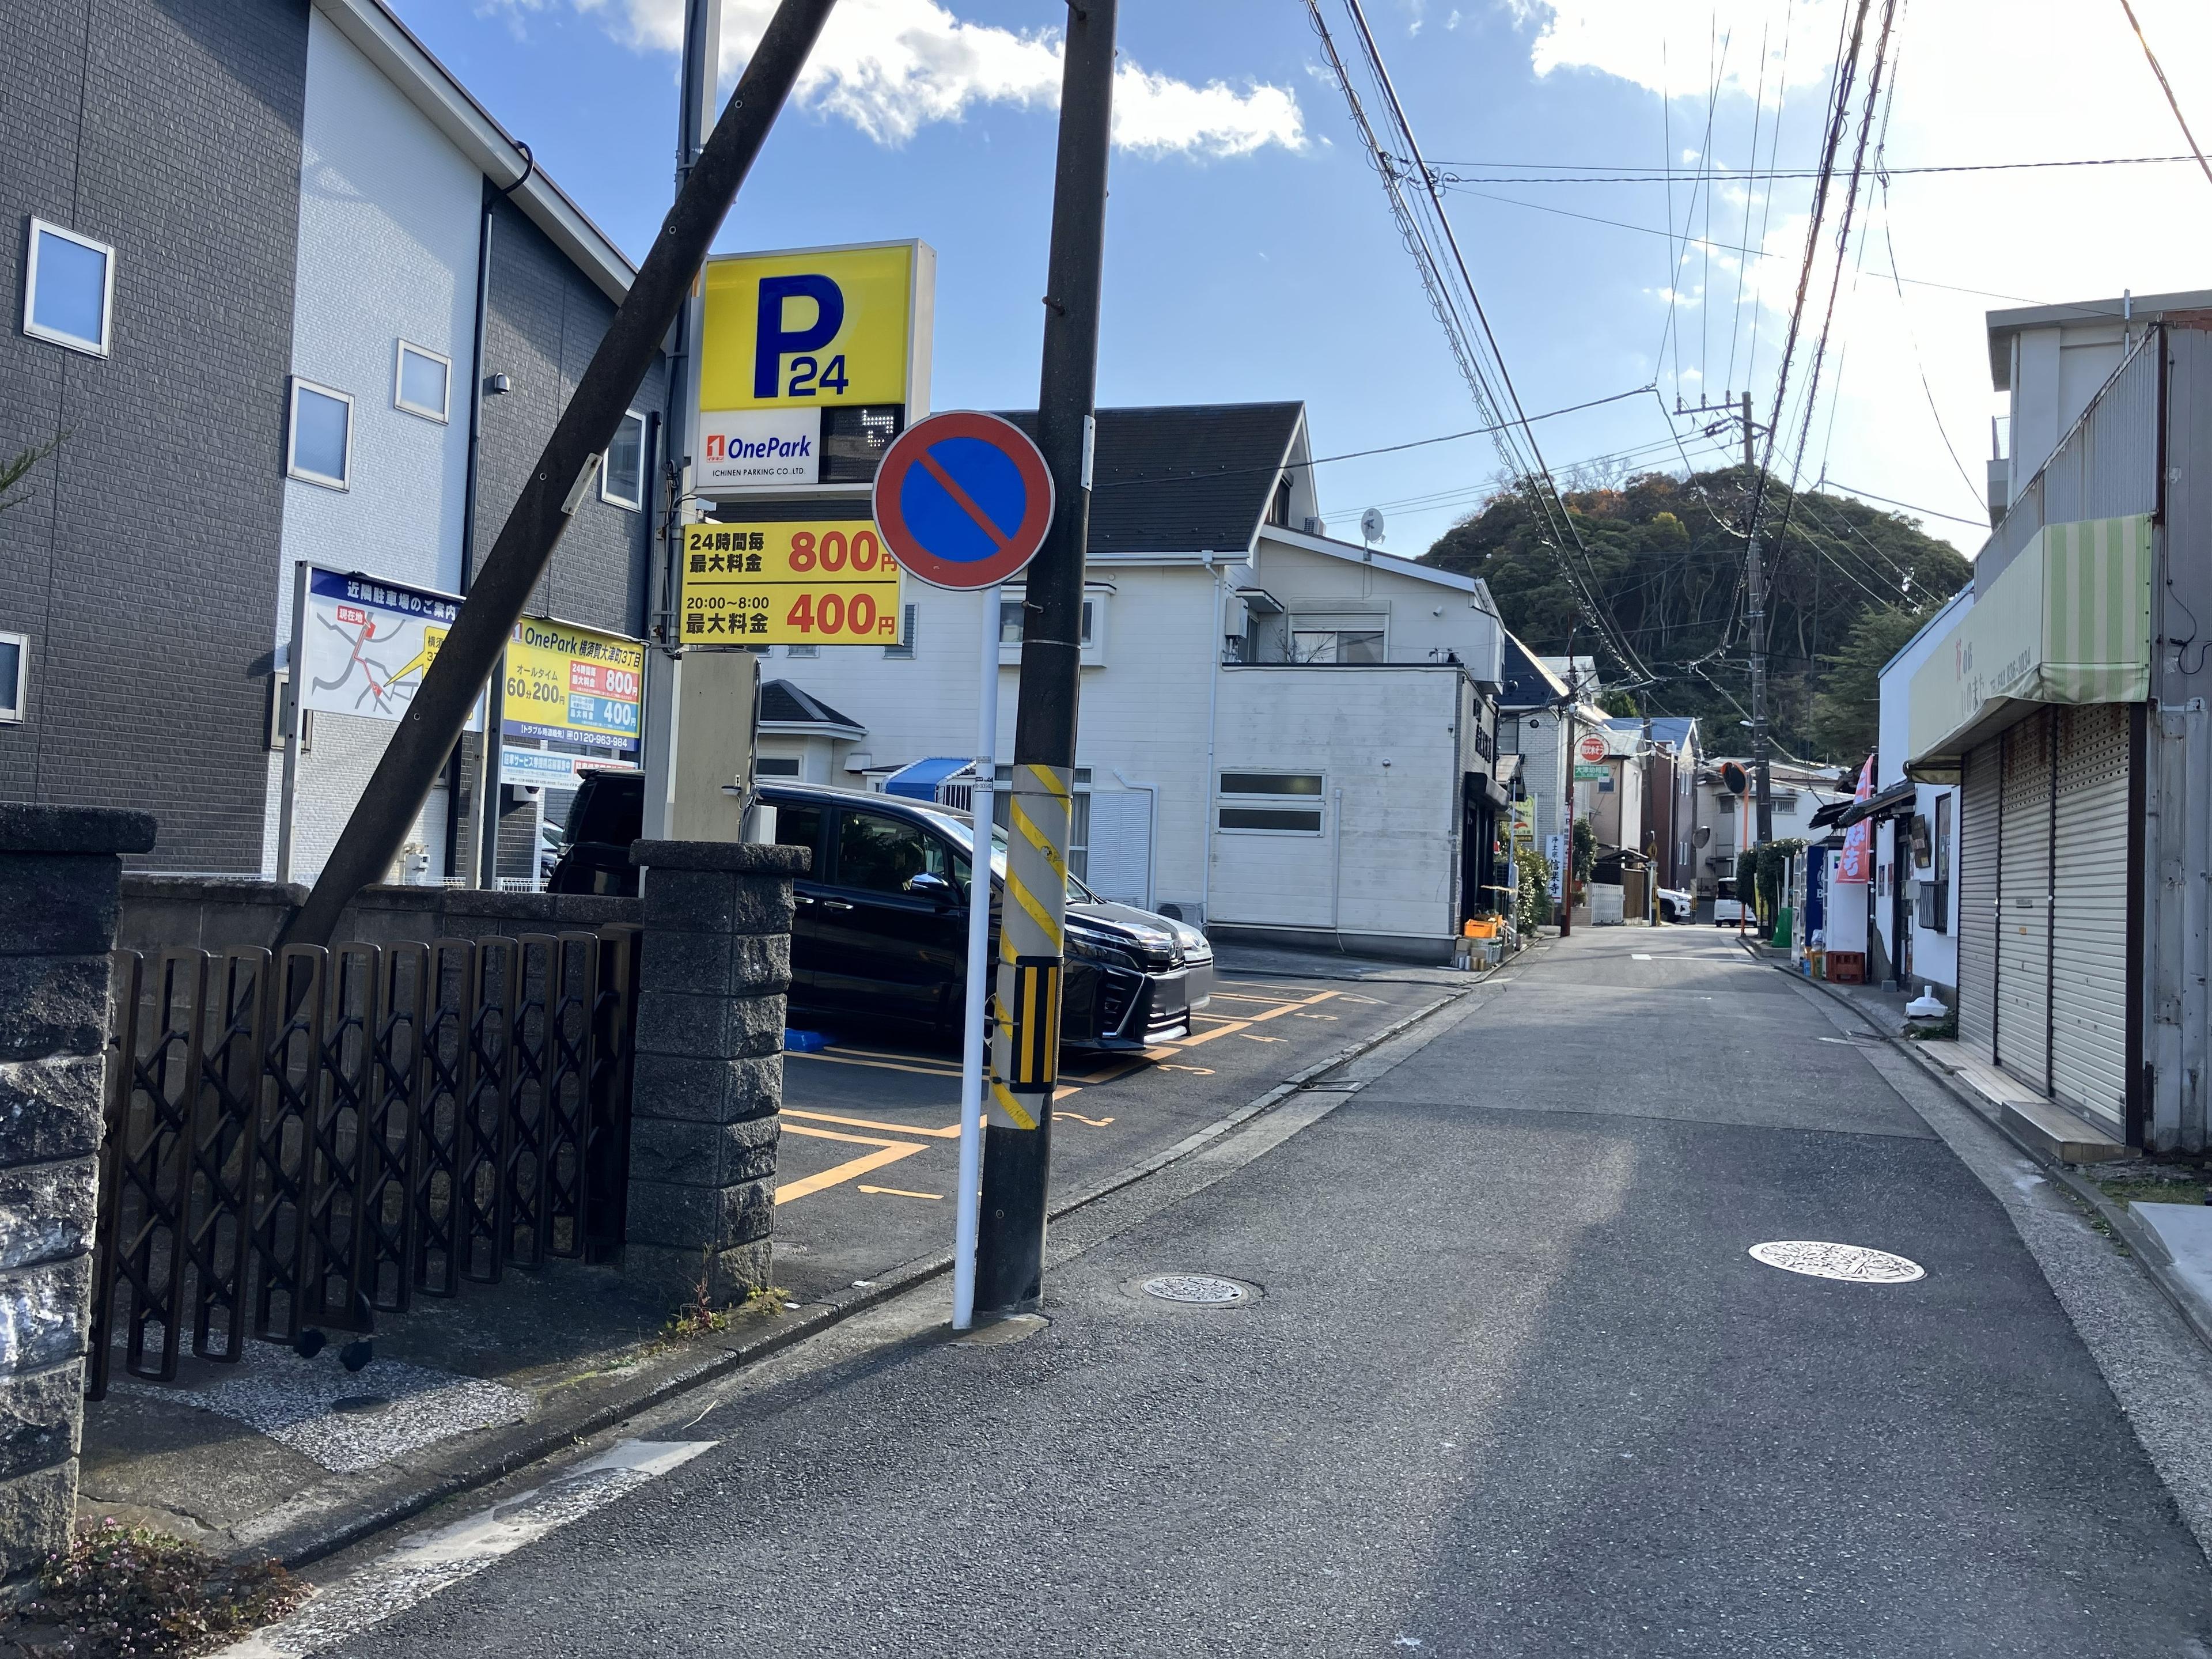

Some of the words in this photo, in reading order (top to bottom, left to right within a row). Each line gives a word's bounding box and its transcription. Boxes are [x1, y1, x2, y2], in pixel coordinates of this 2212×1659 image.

[729, 435, 811, 459] OnePark
[690, 532, 764, 551] 24時間毎
[690, 554, 762, 573] 最大料金
[347, 581, 456, 620] 近隣駐車場のご案内
[339, 608, 362, 623] 現在地
[686, 613, 768, 634] 最大料金
[525, 627, 578, 654] OnePark
[579, 639, 641, 668] 横須賀大津町3丁目
[517, 664, 558, 681] オールタイム
